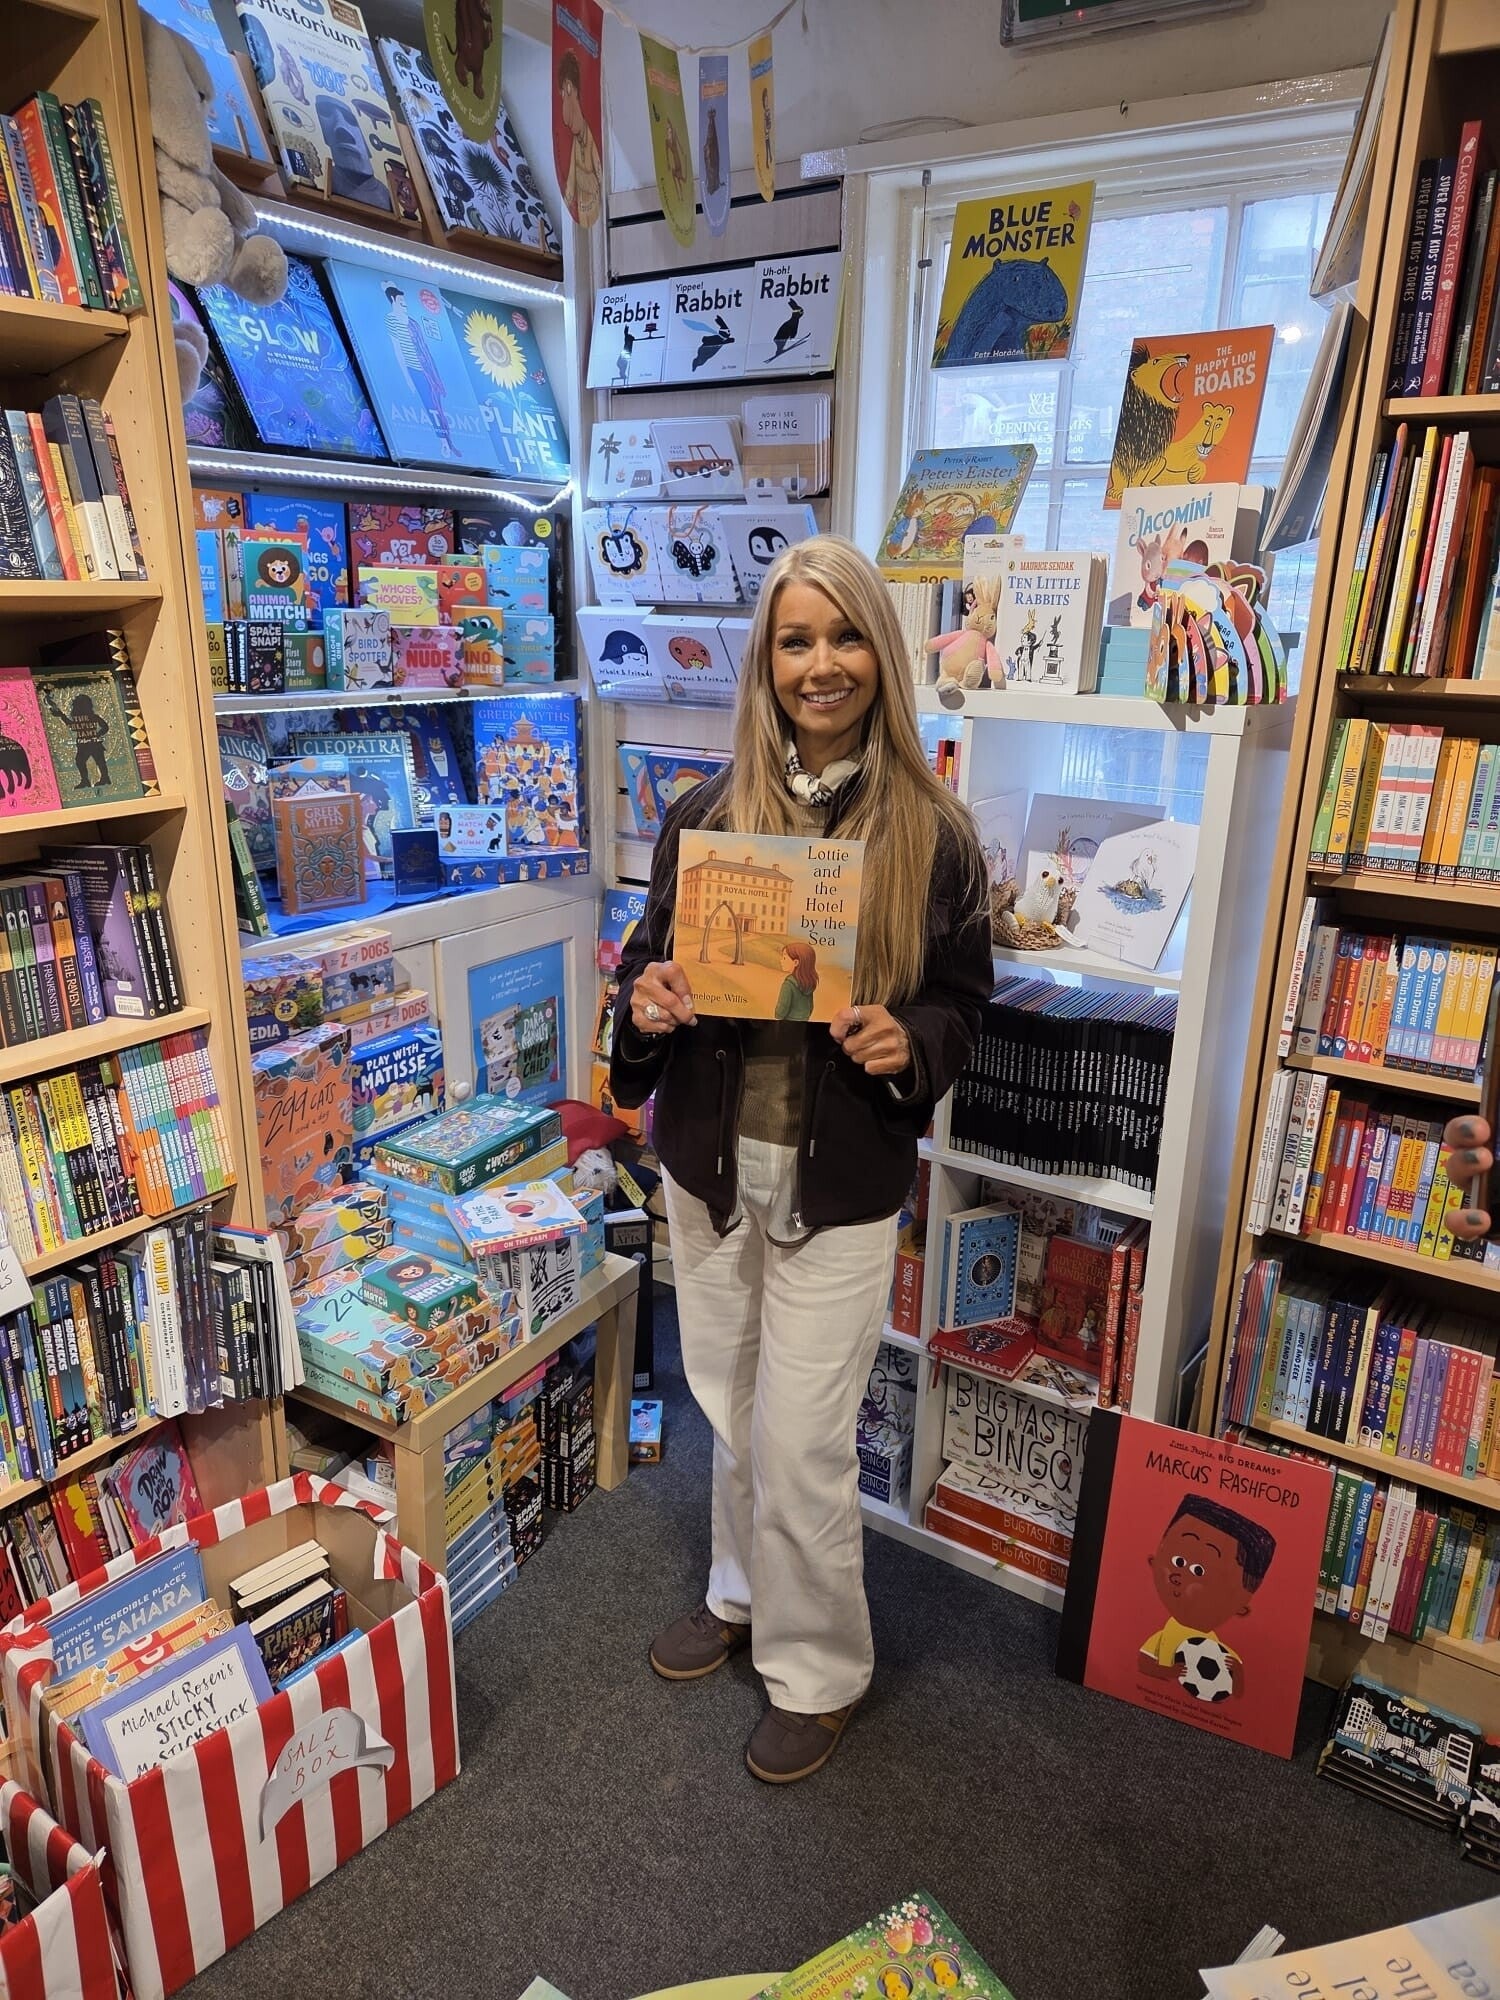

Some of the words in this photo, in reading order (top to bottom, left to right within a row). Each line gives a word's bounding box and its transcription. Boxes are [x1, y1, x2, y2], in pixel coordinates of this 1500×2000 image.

[1418, 177, 1432, 201] SUPER
[1437, 175, 1451, 202] SUPER
[1456, 155, 1473, 202] CLASSIC
[988, 201, 1053, 235] BLUE
[1415, 206, 1428, 238] GREAT
[1432, 205, 1447, 237] GREAT
[1448, 204, 1464, 238] FAIRY
[962, 223, 1076, 259] MONSTER
[1428, 239, 1442, 262] KIDS'
[762, 265, 791, 276] Uh-oh!
[1444, 239, 1459, 275] TALES
[675, 281, 704, 293] Yippee!
[759, 272, 830, 299] Rabbit
[1404, 266, 1420, 303] STORIES
[1422, 265, 1438, 301] STORIES
[601, 300, 661, 325] Rabbit
[603, 295, 627, 305] Oops!
[675, 288, 743, 314] Rabbit
[239, 313, 320, 355] GLOW
[1194, 357, 1229, 375] HAPPY
[1231, 350, 1256, 367] LION
[1216, 345, 1232, 356] THE
[1193, 363, 1256, 397] ROARS
[391, 407, 482, 435] ANATOMY
[483, 403, 559, 441] PLANT
[758, 420, 798, 430] SPRING
[989, 421, 1049, 435] OPENING
[505, 437, 553, 474] LIFE
[920, 468, 964, 481] Peter's
[966, 464, 1016, 481] Easter
[926, 481, 999, 491] Slide-and-Seek
[390, 539, 416, 557] PET
[1020, 561, 1048, 571] MAURICE
[1049, 561, 1075, 570] SENDAK
[380, 584, 417, 595] WHOSE
[1008, 575, 1033, 589] TEN
[1037, 576, 1081, 590] LITTLE
[249, 594, 293, 605] ANIMAL
[250, 605, 305, 620] MATCH
[376, 595, 423, 605] HOOVES?
[1015, 592, 1070, 606] RABBITS
[250, 626, 282, 636] SPACE
[251, 636, 281, 646] SNAP!
[358, 638, 379, 649] BIRD
[286, 649, 299, 657] First
[348, 652, 388, 663] SPOTTER
[406, 650, 451, 669] NUDE
[288, 678, 312, 687] Animals
[478, 710, 518, 720] GREEK
[528, 711, 570, 722] MYTHS
[504, 701, 524, 710] REAL
[525, 702, 553, 711] WOMEN
[303, 738, 401, 755] CLEOPATRA
[304, 806, 341, 819] GREEK
[1470, 794, 1482, 819] BABIES
[304, 815, 344, 828] MYTHS
[808, 846, 849, 862] Lottie
[813, 865, 842, 879] and
[246, 880, 261, 910] CAMINO
[724, 886, 747, 896] ROYAL
[748, 888, 769, 898] HOTEL
[815, 882, 837, 896] the
[806, 897, 844, 913] Hotel
[801, 915, 818, 932] by
[824, 916, 847, 931] the
[80, 936, 93, 969] CHASER
[808, 932, 836, 948] Sea
[340, 953, 348, 969] Z
[361, 940, 390, 962] DOGS
[43, 963, 60, 1023] FRANKENSTEIN
[67, 972, 80, 1012] RAVEN
[691, 991, 721, 1002] nelope
[724, 993, 749, 1004] Willis
[1286, 974, 1300, 1014] MACHINES
[383, 1015, 391, 1030] Z
[401, 1001, 427, 1021] DOGS
[523, 1012, 544, 1032] DARA
[1394, 998, 1407, 1024] Driver
[1409, 999, 1421, 1027] Driver
[1424, 1002, 1437, 1030] Driver
[366, 1055, 390, 1072] PLAY
[393, 1043, 419, 1059] WITH
[523, 1056, 550, 1078] CHILD
[361, 1053, 427, 1092] MATISSE
[85, 1100, 104, 1152] MISFORTUNES
[265, 1087, 308, 1148] 299
[310, 1082, 337, 1113] CATS
[28, 1114, 45, 1163] STARCAT
[1284, 1133, 1299, 1164] GARAGE
[1296, 1136, 1313, 1169] MUSEUM
[503, 1241, 513, 1249] ON
[515, 1238, 528, 1247] THE
[530, 1234, 548, 1245] FARM
[152, 1239, 168, 1274] BLOW
[1051, 1255, 1110, 1282] ADVENTURE
[155, 1275, 171, 1295] UP!
[409, 1274, 465, 1304] MATCH
[903, 1263, 915, 1288] DOGS
[41, 1328, 57, 1376] SIDEKICKS
[53, 1323, 67, 1371] SIDEKICKS
[64, 1317, 79, 1365] SIDEKICKS
[860, 1451, 890, 1472] BINGO
[974, 1414, 1072, 1491] BINGO
[1169, 1440, 1189, 1451] Little
[1218, 1454, 1235, 1464] BIG
[138, 1451, 167, 1504] DRAW
[860, 1472, 890, 1493] BINGO
[1146, 1450, 1212, 1484] MARCUS
[1219, 1468, 1300, 1508] RASHFORD
[153, 1478, 176, 1519] ROB
[1360, 1493, 1372, 1515] Story
[1003, 1513, 1060, 1549] BUGTASTIC
[1339, 1512, 1351, 1541] Football
[1355, 1515, 1367, 1535] Path
[991, 1537, 1050, 1573] BUGTASTIC
[1380, 1537, 1391, 1564] Puppies
[93, 1593, 150, 1632] INCREDIBLE
[152, 1571, 187, 1597] PLACES
[55, 1638, 97, 1678] THE
[101, 1583, 192, 1649] SAHARA
[263, 1605, 324, 1649] PIRATE
[121, 1690, 181, 1737] Michael
[182, 1661, 234, 1703] Rosen's
[156, 1693, 217, 1746] STICKY
[1387, 1701, 1410, 1718] Look
[1422, 1716, 1438, 1730] the
[1389, 1715, 1432, 1744] City
[283, 1717, 339, 1773] SALE
[291, 1744, 352, 1796] BOX
[828, 1956, 874, 1988] Counting
